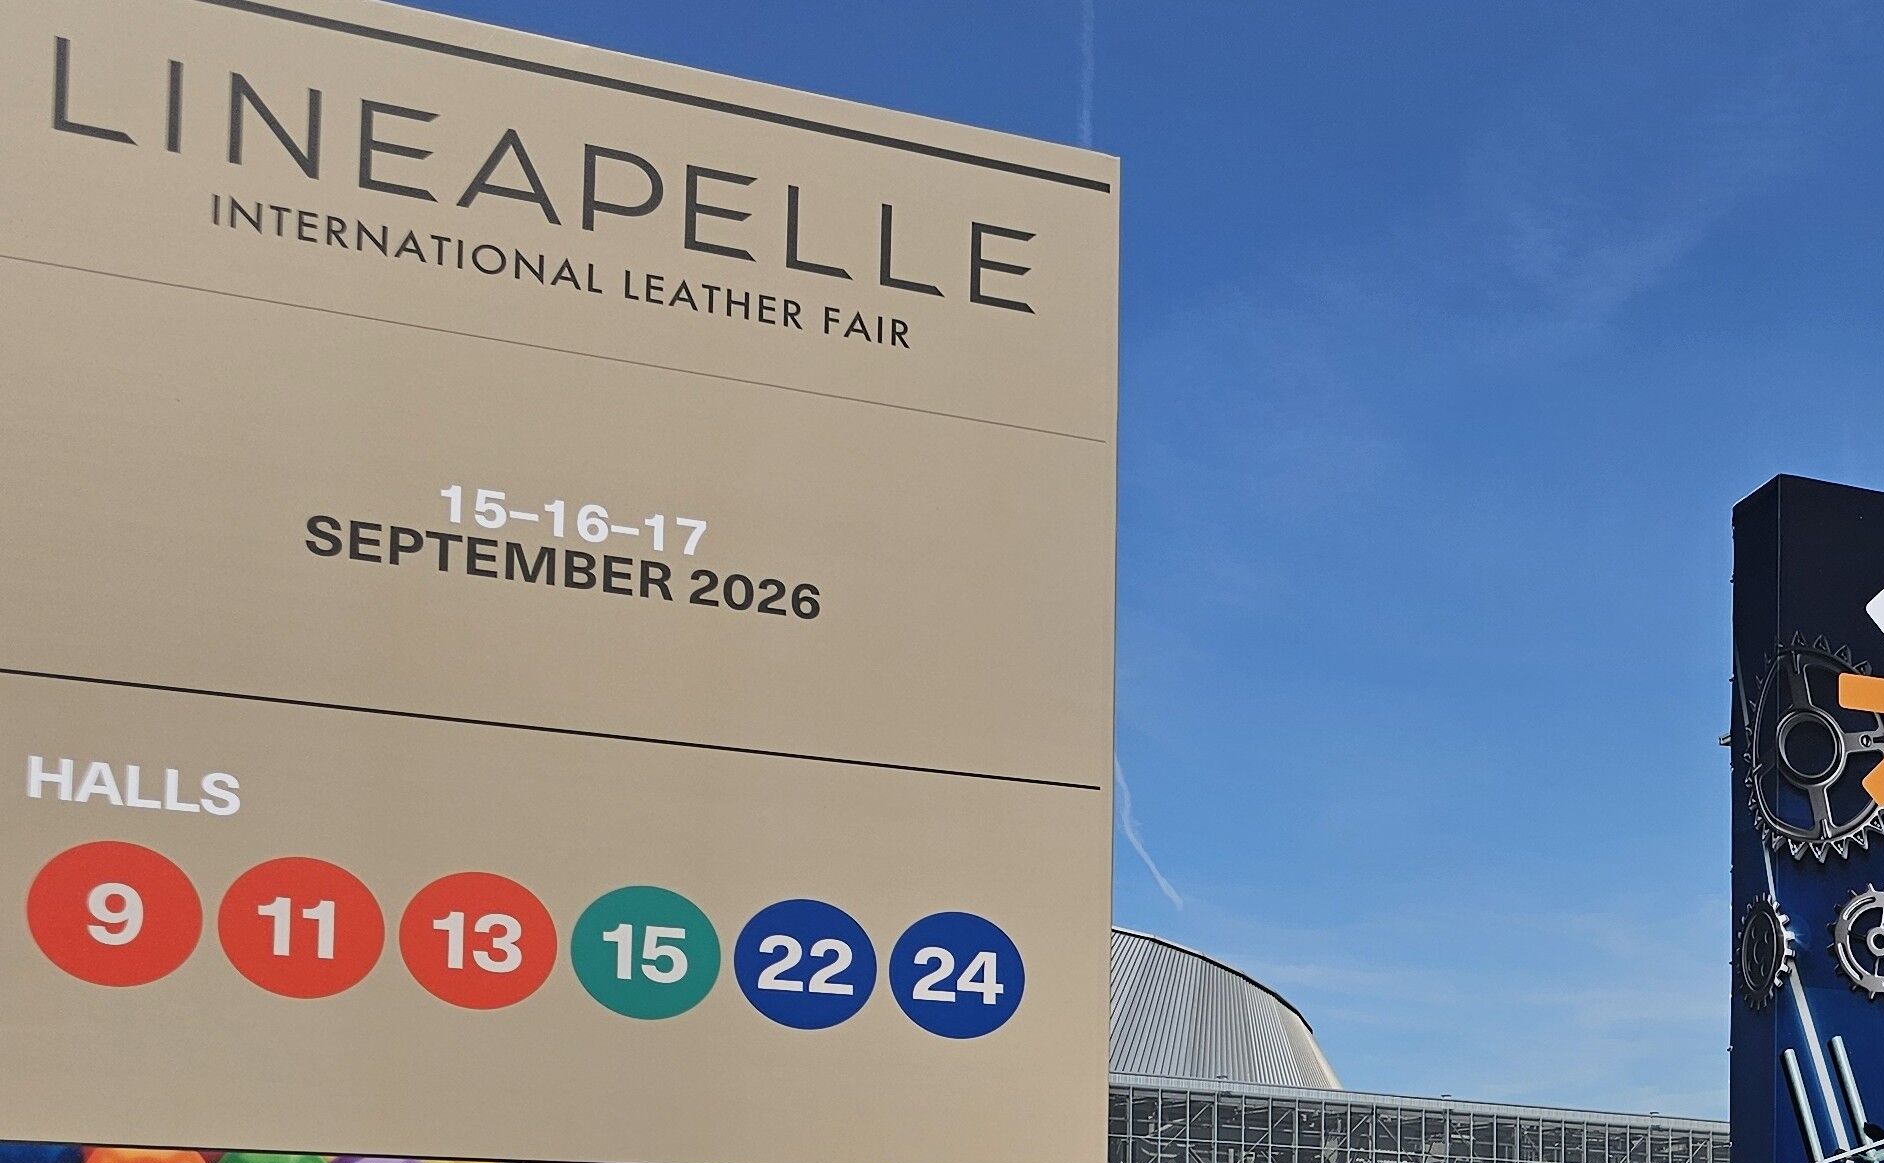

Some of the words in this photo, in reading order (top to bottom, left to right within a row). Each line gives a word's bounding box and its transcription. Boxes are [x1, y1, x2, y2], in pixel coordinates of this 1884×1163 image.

[52, 35, 1036, 313] LINEAPELLE
[209, 194, 603, 294] INTERNATIONAL
[623, 269, 802, 330] LEATHER
[823, 306, 911, 349] FAIR
[304, 514, 673, 601] SEPTEMBER
[689, 568, 821, 620] 2026
[27, 755, 241, 816] HALLS
[87, 883, 144, 945] 9
[257, 897, 336, 959] 11
[432, 913, 522, 973] 13
[602, 923, 688, 984] 15
[757, 936, 854, 994] 22
[912, 947, 1003, 1006] 24
